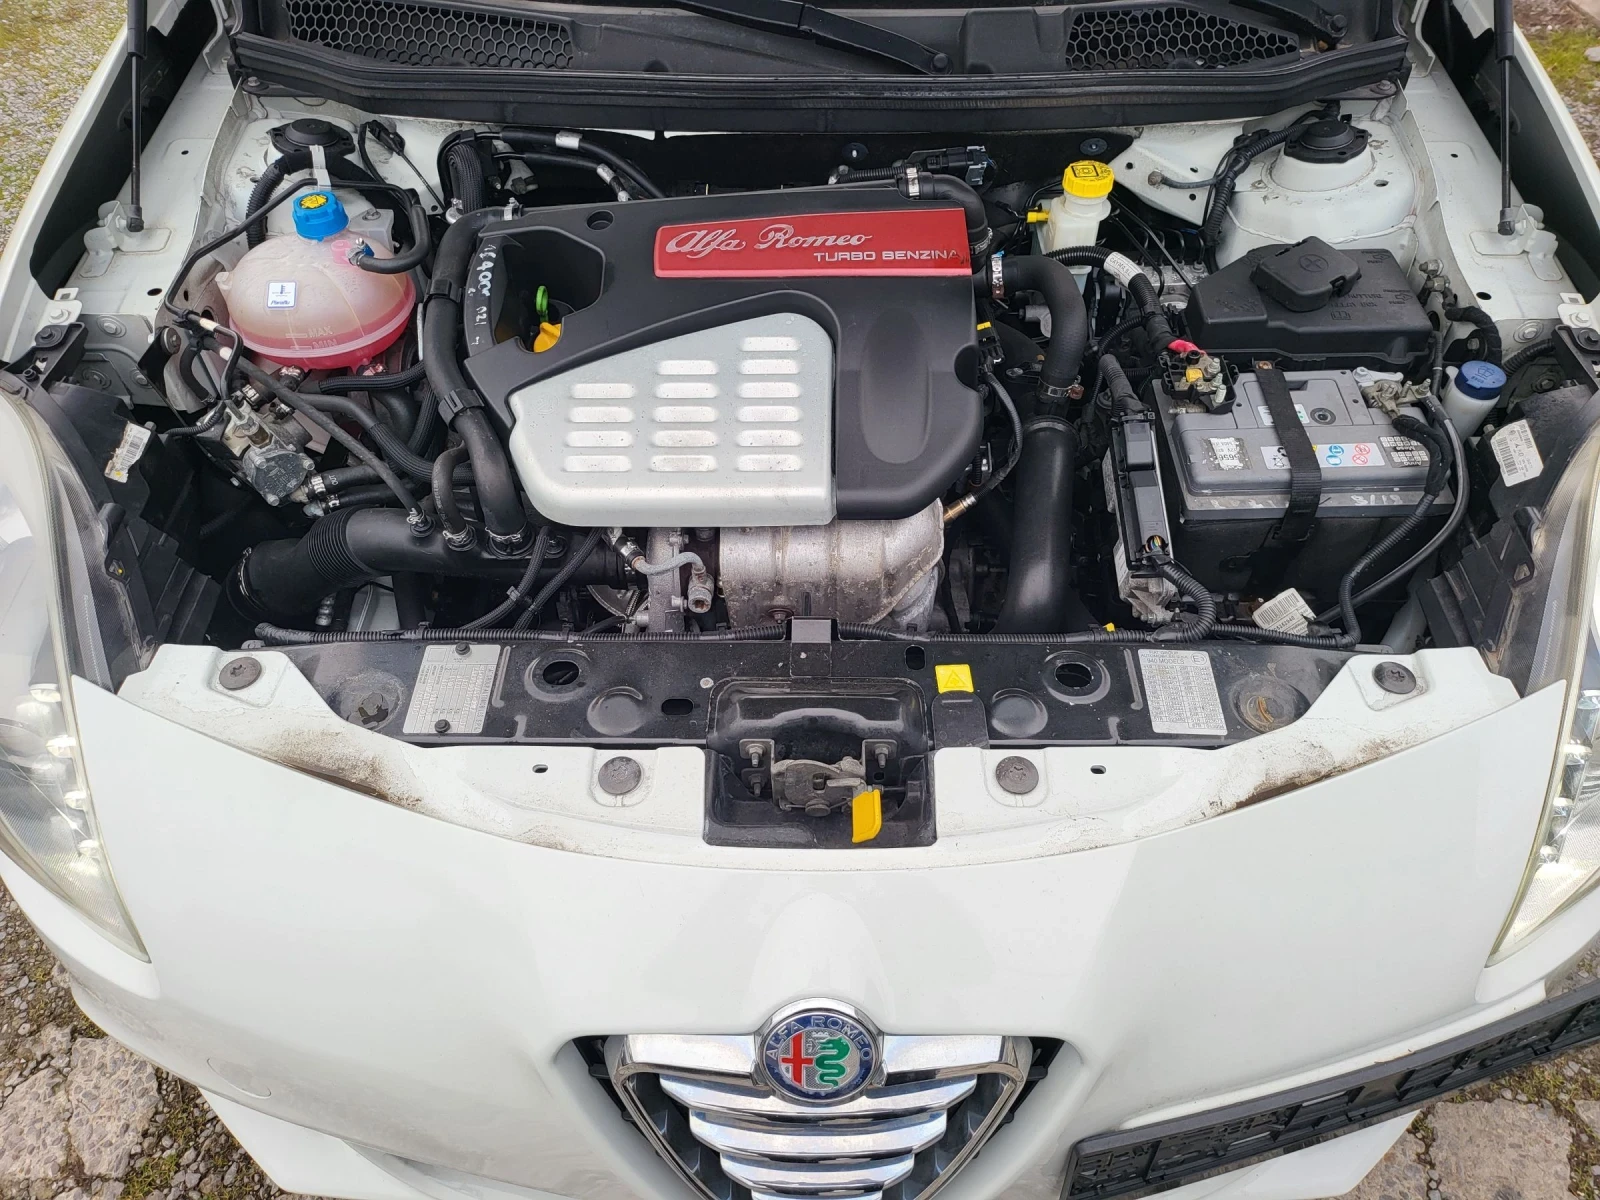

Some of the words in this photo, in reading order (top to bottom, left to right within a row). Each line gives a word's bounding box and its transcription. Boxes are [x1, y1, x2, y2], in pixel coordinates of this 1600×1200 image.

[665, 228, 747, 259] Alfa
[754, 223, 873, 250] Romeo
[813, 251, 877, 262] TURBO
[881, 250, 960, 260] BENZINA
[308, 325, 333, 338] MAX
[312, 338, 337, 349] MIN
[328, 474, 339, 486] OUT
[766, 1021, 804, 1061] ALFA
[811, 1015, 873, 1061] ROMEO
